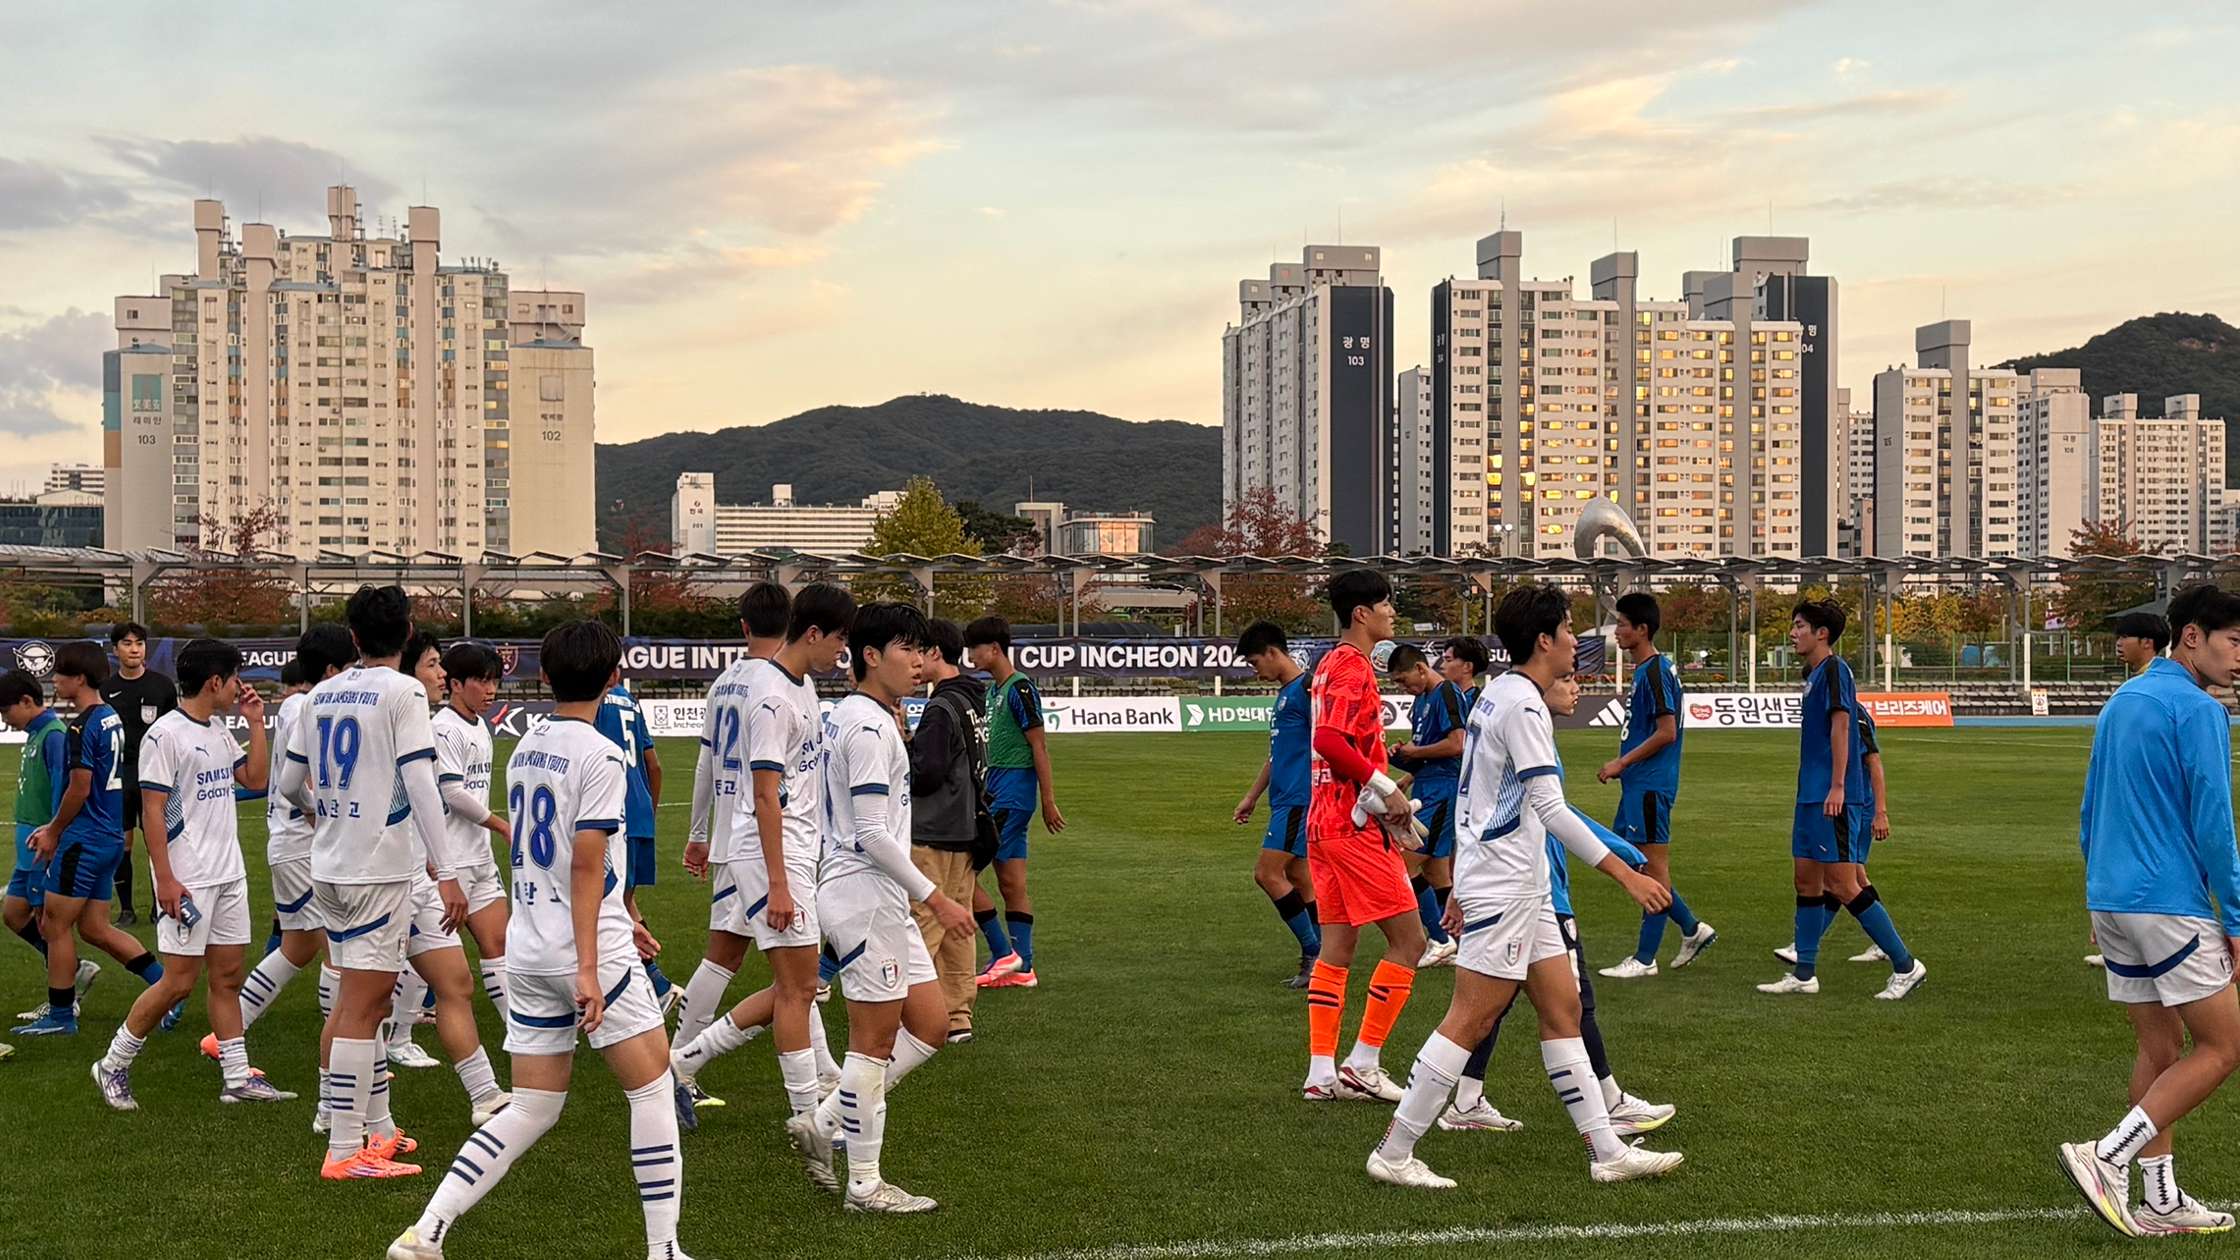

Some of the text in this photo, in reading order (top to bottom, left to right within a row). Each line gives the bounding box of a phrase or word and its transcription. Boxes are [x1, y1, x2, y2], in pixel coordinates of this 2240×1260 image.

[1801, 343, 1814, 353] 04
[1347, 355, 1365, 366] 103
[138, 434, 156, 445] 103
[542, 430, 561, 441] 102
[1020, 646, 1075, 669] CUP
[1081, 646, 1197, 669] INCHEON
[1203, 646, 1256, 669] 202
[1072, 708, 1174, 725] Hana Bank
[1714, 697, 1803, 725] 동원샘물
[1875, 700, 1948, 715] 브리즈케어
[619, 709, 637, 768] 5
[713, 704, 741, 771] 12
[317, 714, 361, 790] 19
[510, 782, 557, 871] 28
